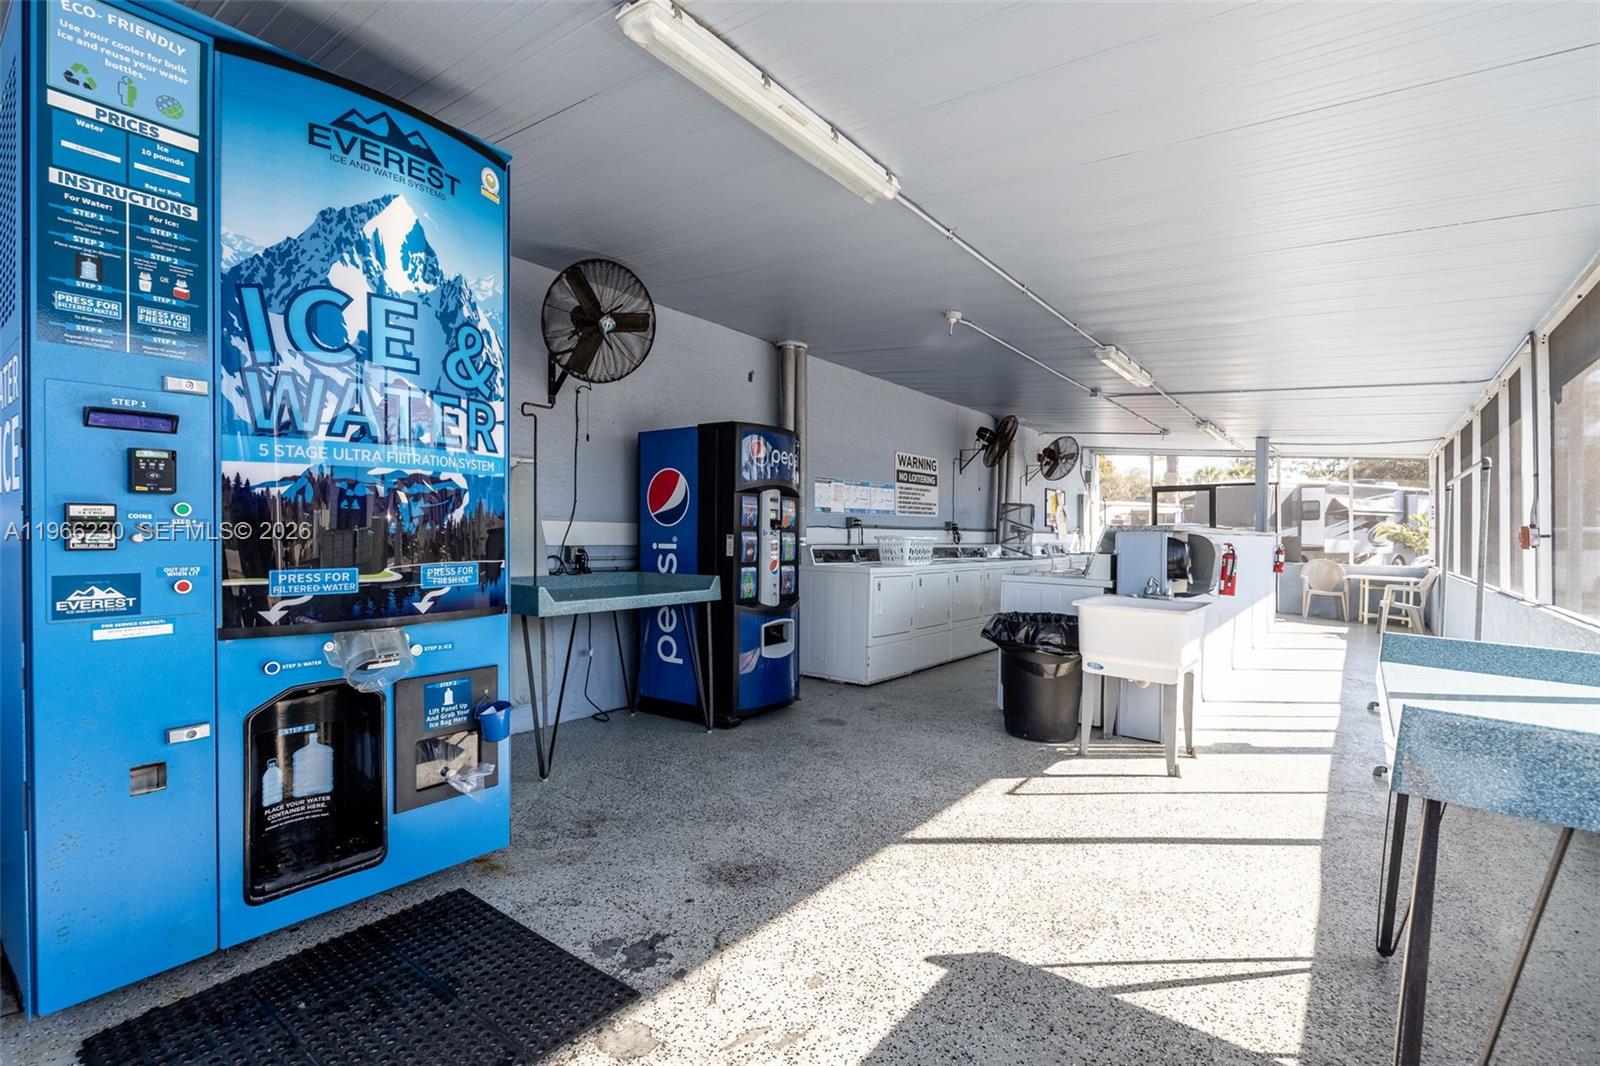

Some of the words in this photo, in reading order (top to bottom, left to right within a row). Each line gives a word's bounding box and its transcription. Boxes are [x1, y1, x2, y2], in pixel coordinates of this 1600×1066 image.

[108, 14, 187, 56] FRIENDLY
[60, 19, 80, 33] Use
[84, 28, 109, 44] your
[112, 40, 145, 58] cooler
[148, 52, 162, 64] for
[165, 59, 187, 74] bulk
[57, 30, 74, 42] ice
[76, 37, 98, 51] and
[100, 48, 130, 63] reuse
[132, 59, 157, 74] your
[160, 69, 189, 86] water
[104, 58, 147, 81] bottles.
[76, 118, 104, 134] Water
[96, 108, 160, 138] PRICES
[157, 144, 170, 154] Ice
[141, 148, 152, 157] 10
[154, 152, 184, 167] pounds
[308, 122, 461, 196] EVEREST
[330, 152, 348, 166] ICE
[349, 159, 371, 172] AND
[372, 166, 406, 185] WATER
[408, 179, 446, 200] SYSTEMS
[58, 171, 192, 218] INSTRUCTIONS
[64, 192, 80, 202] For
[82, 198, 113, 211] Water:
[72, 207, 97, 219] STEP
[149, 215, 162, 223] For
[165, 219, 180, 228] Ice:
[150, 227, 171, 237] STEP
[72, 235, 97, 246] STEP
[150, 253, 171, 263] STEP
[76, 281, 96, 290] STEP
[58, 294, 94, 307] PRESS
[97, 301, 118, 311] FOR
[58, 302, 92, 312] FILTERED
[140, 308, 168, 319] PRESS
[170, 313, 188, 322] FOR
[140, 315, 171, 325] FRESH
[173, 321, 188, 329] ICE
[235, 283, 420, 376] ICE
[444, 322, 497, 398] &
[111, 398, 138, 407] STEP
[242, 370, 499, 454] WATER
[258, 444, 269, 457] 5
[275, 446, 328, 460] STAGE
[333, 448, 383, 462] ULTRA
[387, 452, 456, 468] FILTRATION
[458, 458, 494, 472] SYSTEM
[898, 454, 937, 472] WARNING
[899, 472, 908, 480] NO
[909, 473, 936, 484] LOITERING
[278, 574, 321, 584] PRESS
[325, 572, 350, 582] FOR
[427, 568, 456, 577] PRESS
[457, 566, 474, 575] FOR
[272, 585, 319, 594] FILTERED
[321, 583, 356, 592] WATER
[433, 577, 454, 585] FRESH
[456, 576, 472, 584] ICE
[56, 598, 136, 611] EVEREST
[652, 542, 684, 664] pesi
[284, 726, 303, 734] STEP
[264, 804, 284, 815] PLACE
[286, 800, 305, 808] YOUR
[307, 796, 331, 804] WATER
[267, 805, 306, 820] CONTAINER
[307, 802, 327, 810] HERE.
